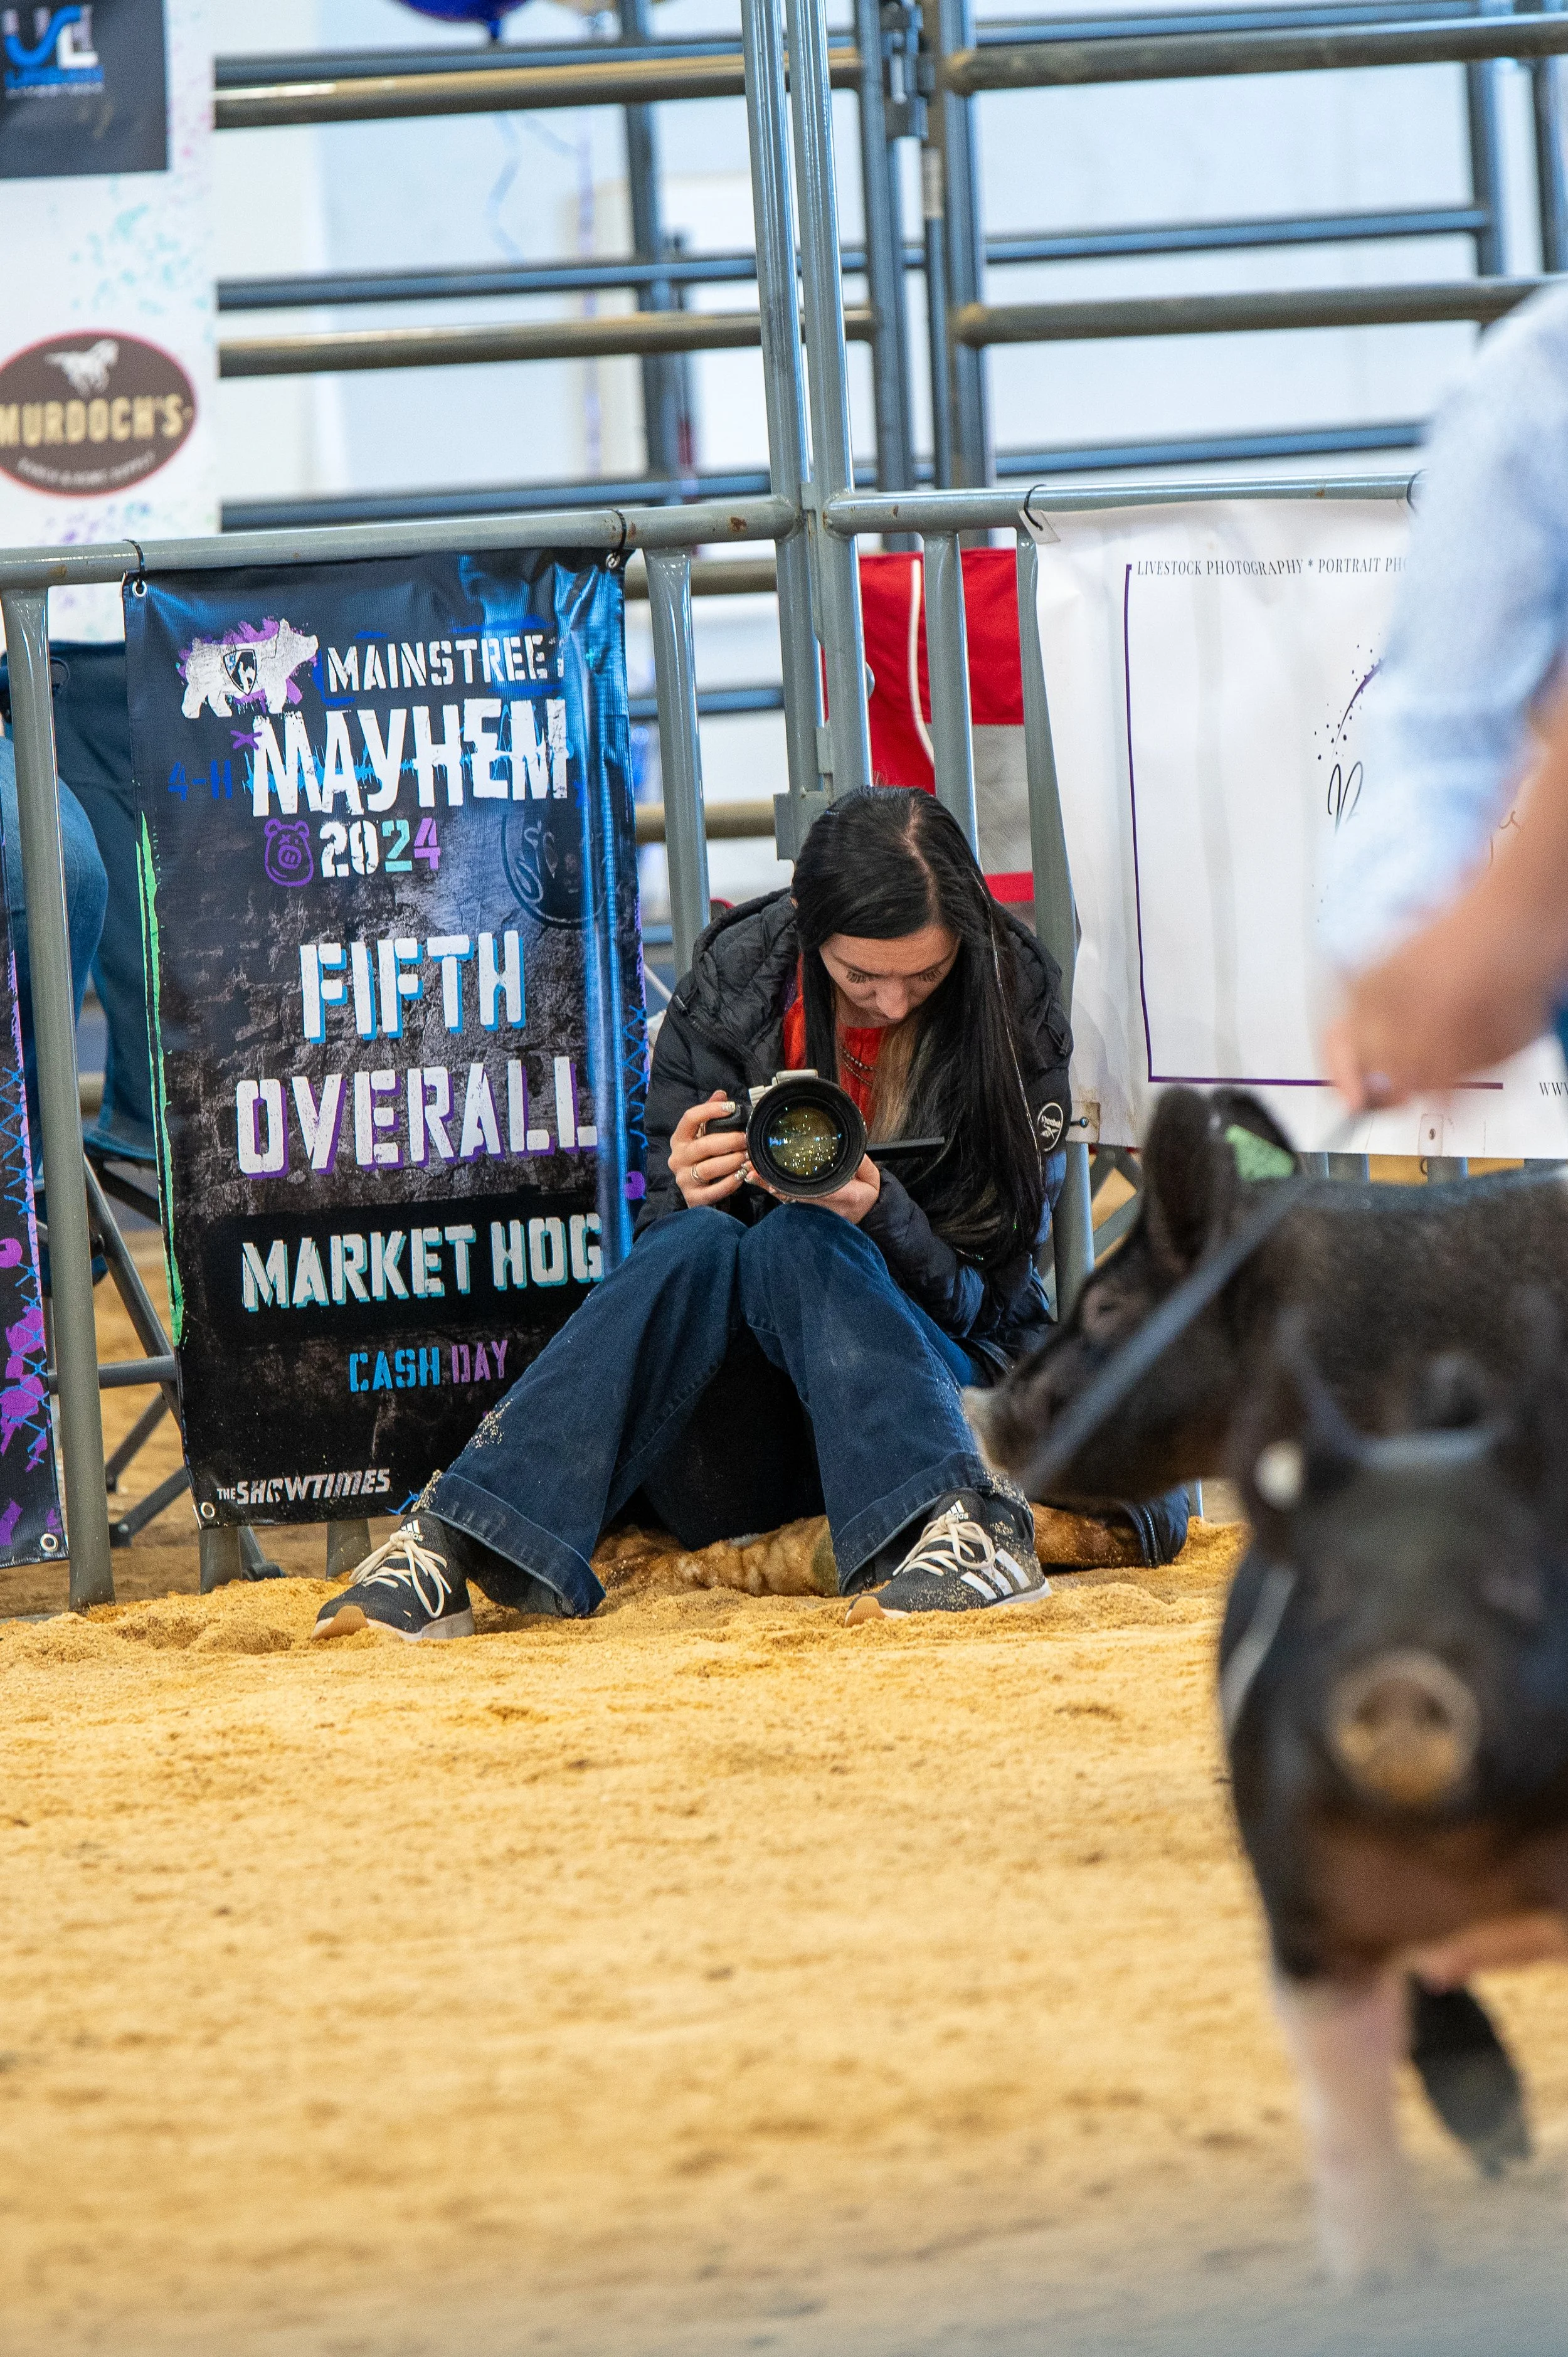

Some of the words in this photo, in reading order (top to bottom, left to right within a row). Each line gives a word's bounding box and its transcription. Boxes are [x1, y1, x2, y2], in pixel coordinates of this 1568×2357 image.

[0, 393, 184, 448] MURDOCH'S
[1137, 560, 1201, 575] LIVESTOCK
[1207, 559, 1303, 576] PHOTOGRAPHY
[1319, 557, 1381, 573] PORTRAIT
[168, 760, 233, 802] 4-H
[252, 698, 568, 817] MAYHEM
[319, 817, 442, 877] 2024
[300, 930, 526, 1044] FIFTH
[236, 1056, 598, 1180] OVERALL
[242, 1224, 476, 1312] MARKET
[491, 1212, 605, 1290] HOG
[349, 1347, 441, 1393] CASH
[452, 1340, 509, 1384] DAY
[216, 1487, 235, 1500] THE
[236, 1468, 390, 1505] SHOWTIMES
